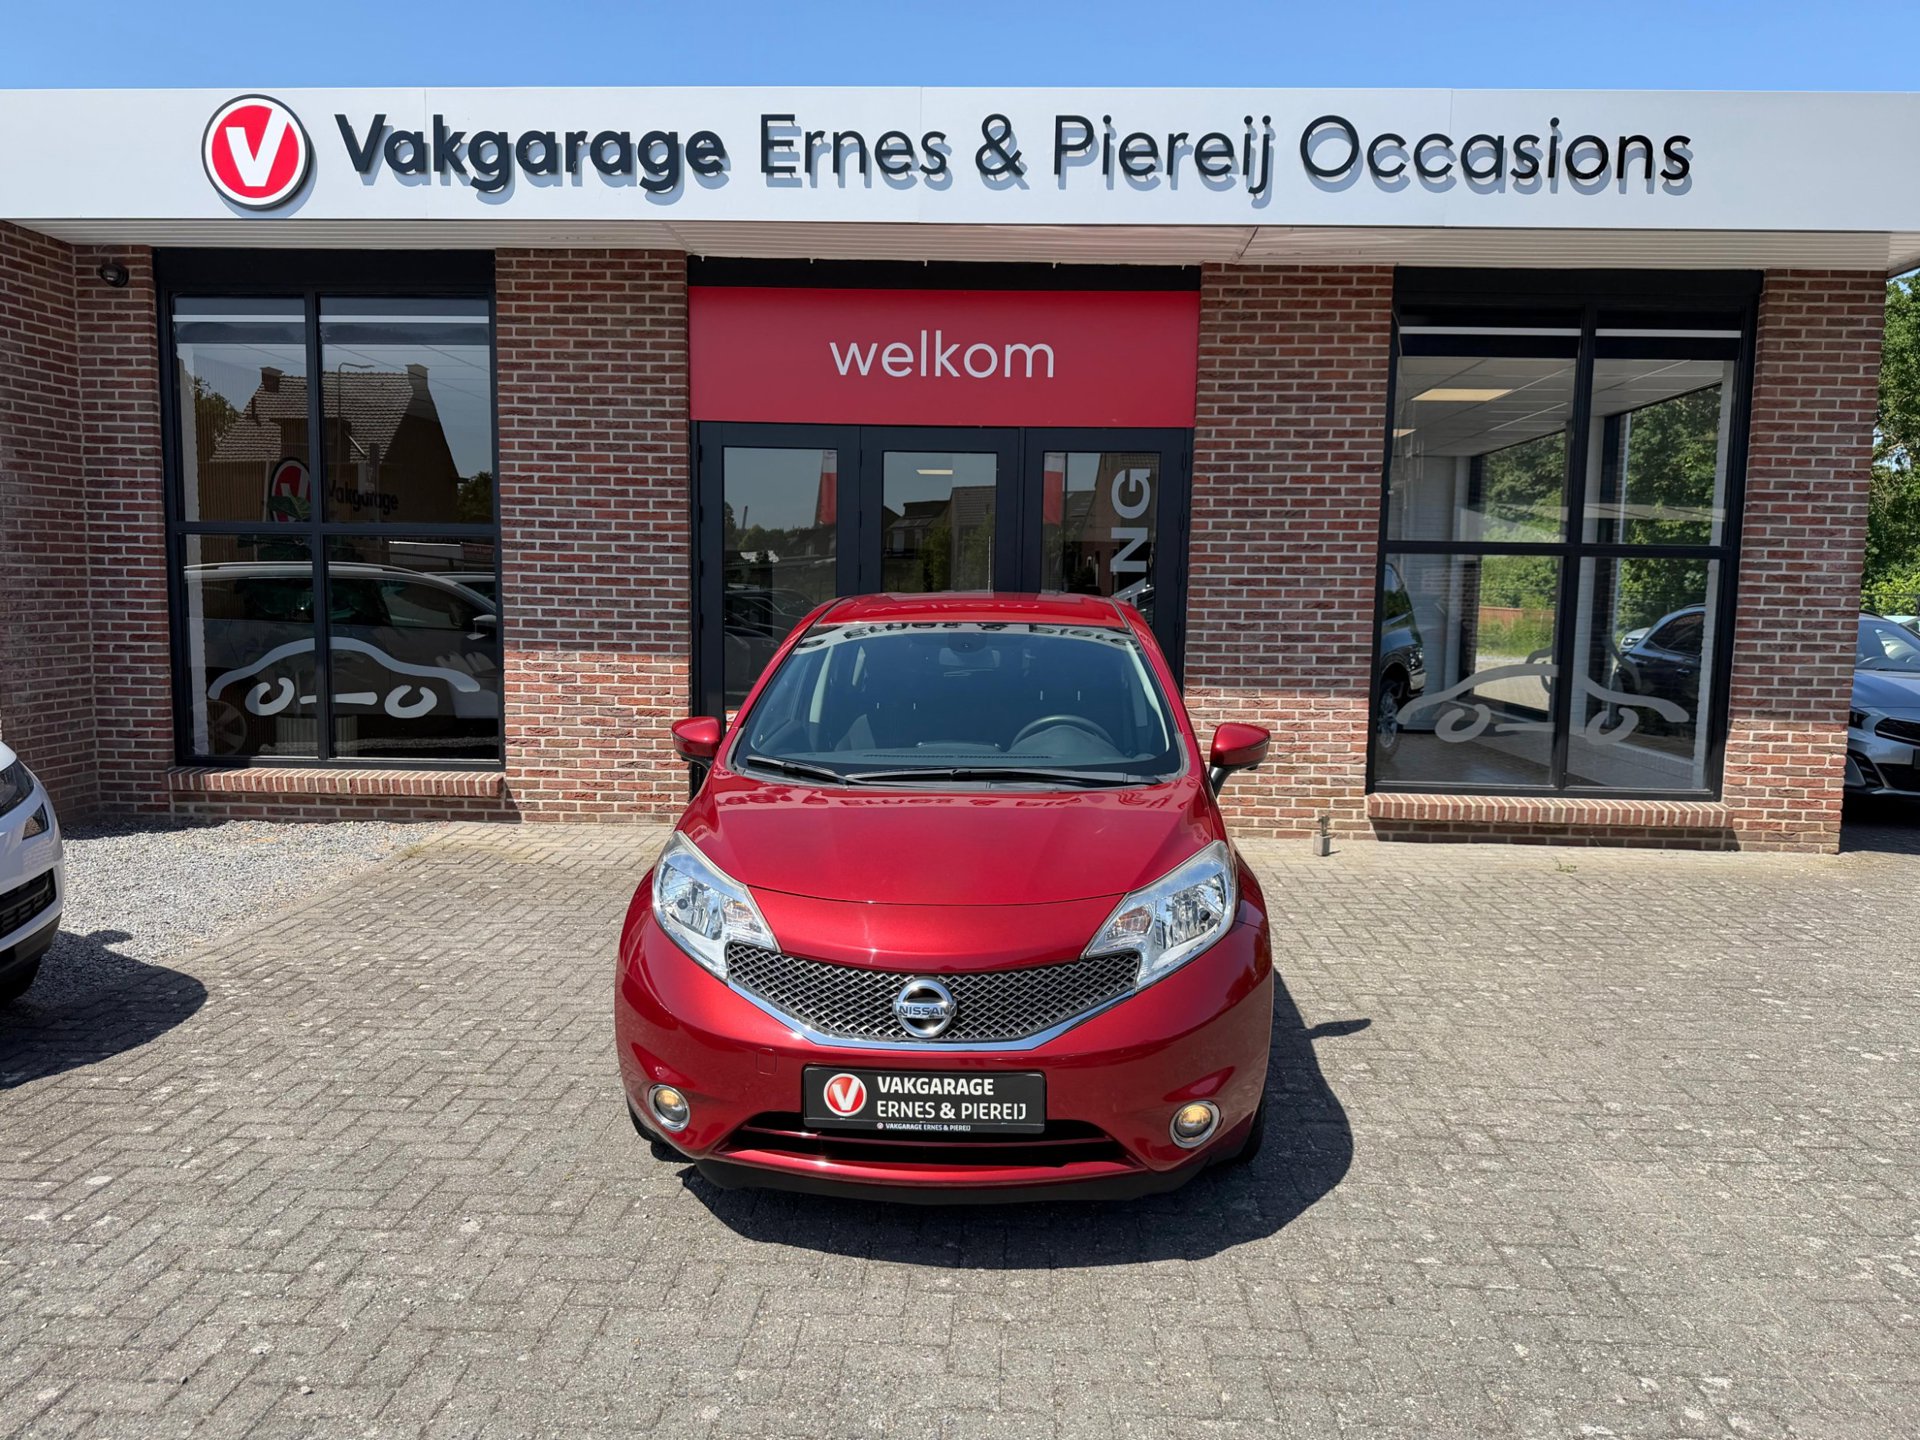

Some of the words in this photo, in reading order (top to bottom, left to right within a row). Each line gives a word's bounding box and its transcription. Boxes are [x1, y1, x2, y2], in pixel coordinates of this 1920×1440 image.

[333, 113, 726, 193] Vakgarage
[758, 113, 948, 176] Ernes
[974, 114, 1024, 177] &
[1053, 114, 1272, 195] Piereij
[1299, 114, 1692, 181] Occasions
[829, 329, 1055, 379] welkom
[898, 1005, 951, 1017] NISSAN
[876, 1076, 994, 1096] VAKGARAGE
[876, 1101, 936, 1119] ERNES
[939, 1103, 957, 1120] &
[961, 1103, 1027, 1121] PIEREIJ
[885, 1122, 922, 1131] VAKGARAGE
